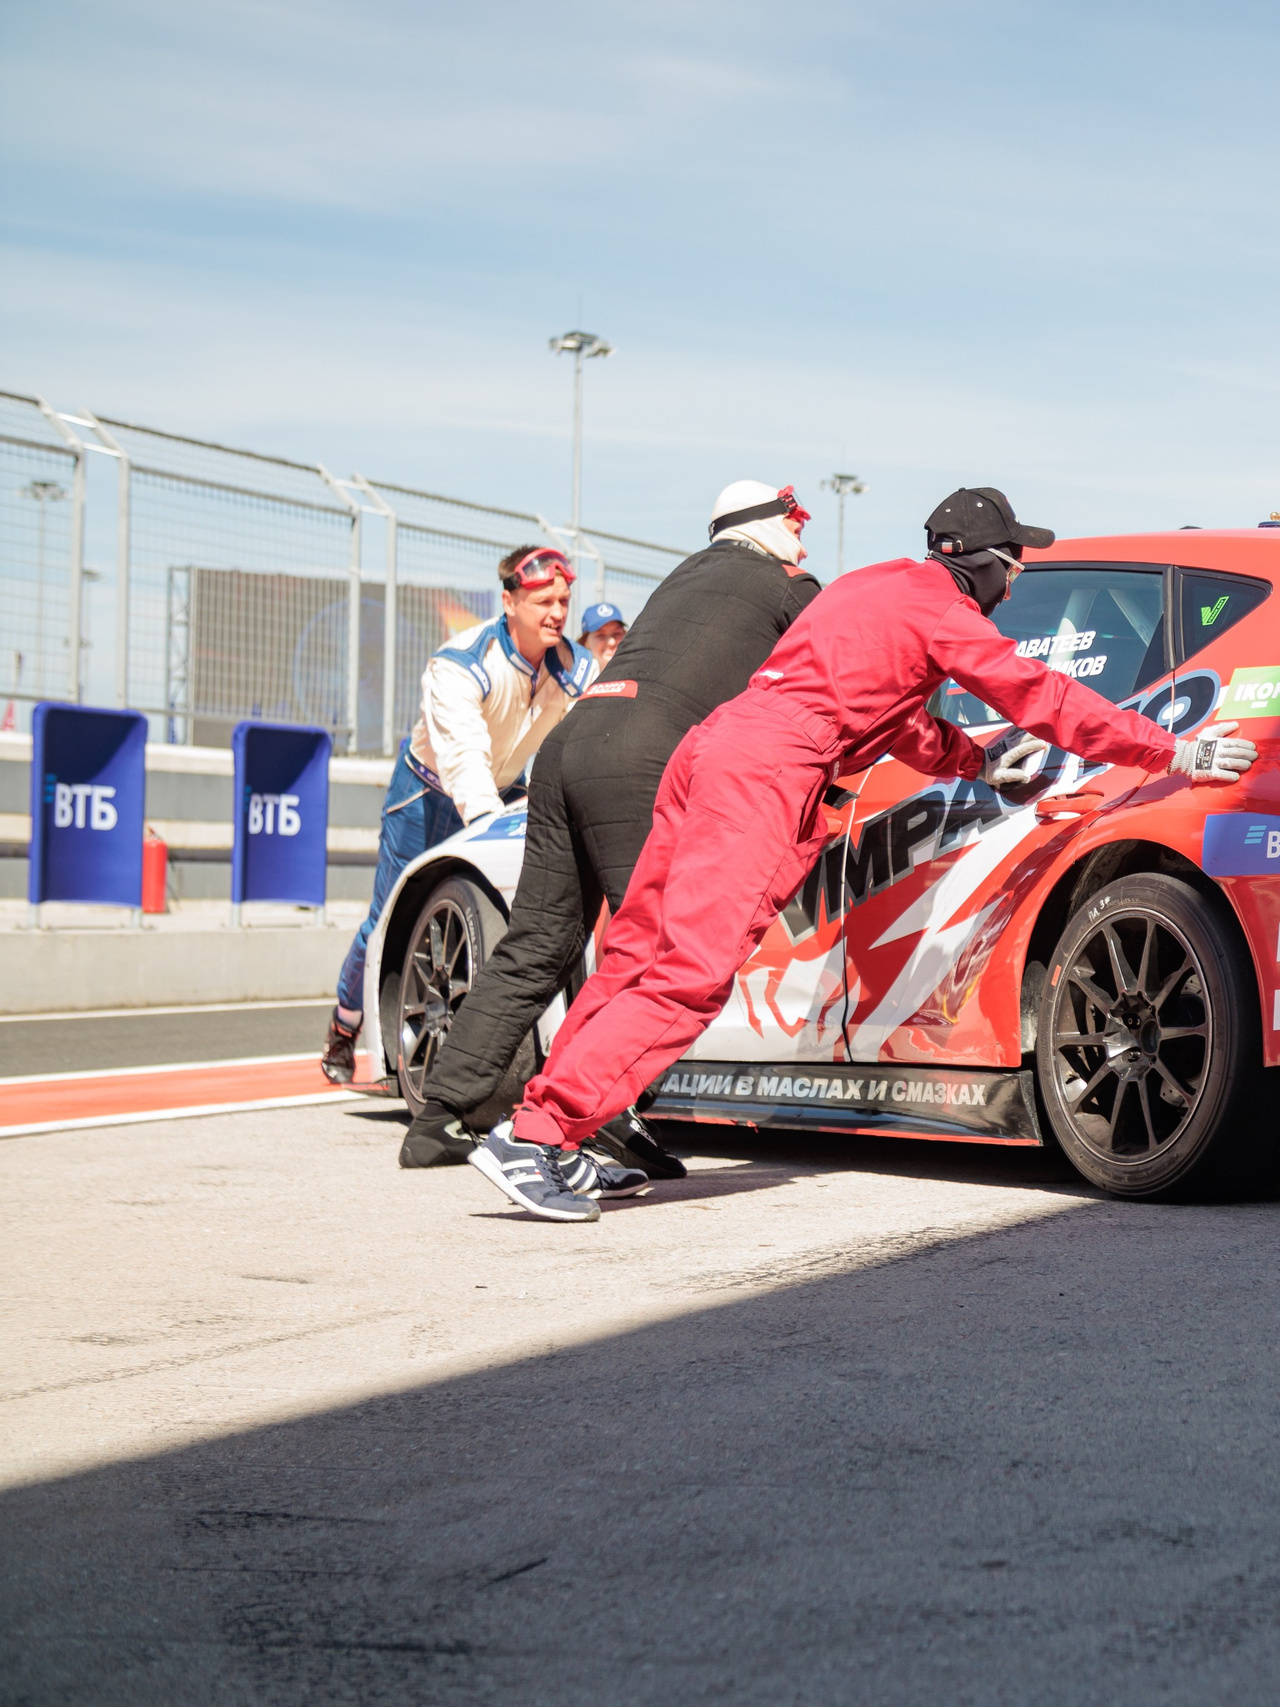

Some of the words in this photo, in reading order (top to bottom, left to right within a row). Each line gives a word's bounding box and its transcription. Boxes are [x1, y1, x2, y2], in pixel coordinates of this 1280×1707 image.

[1047, 655, 1108, 679] ИКОВ
[54, 782, 118, 831] ВТБ
[248, 793, 302, 836] ВТБ
[735, 1074, 754, 1096] В
[756, 1076, 863, 1101] МАСЛАХ
[867, 1079, 888, 1101] И
[891, 1081, 987, 1107] СМАЗКАХ
